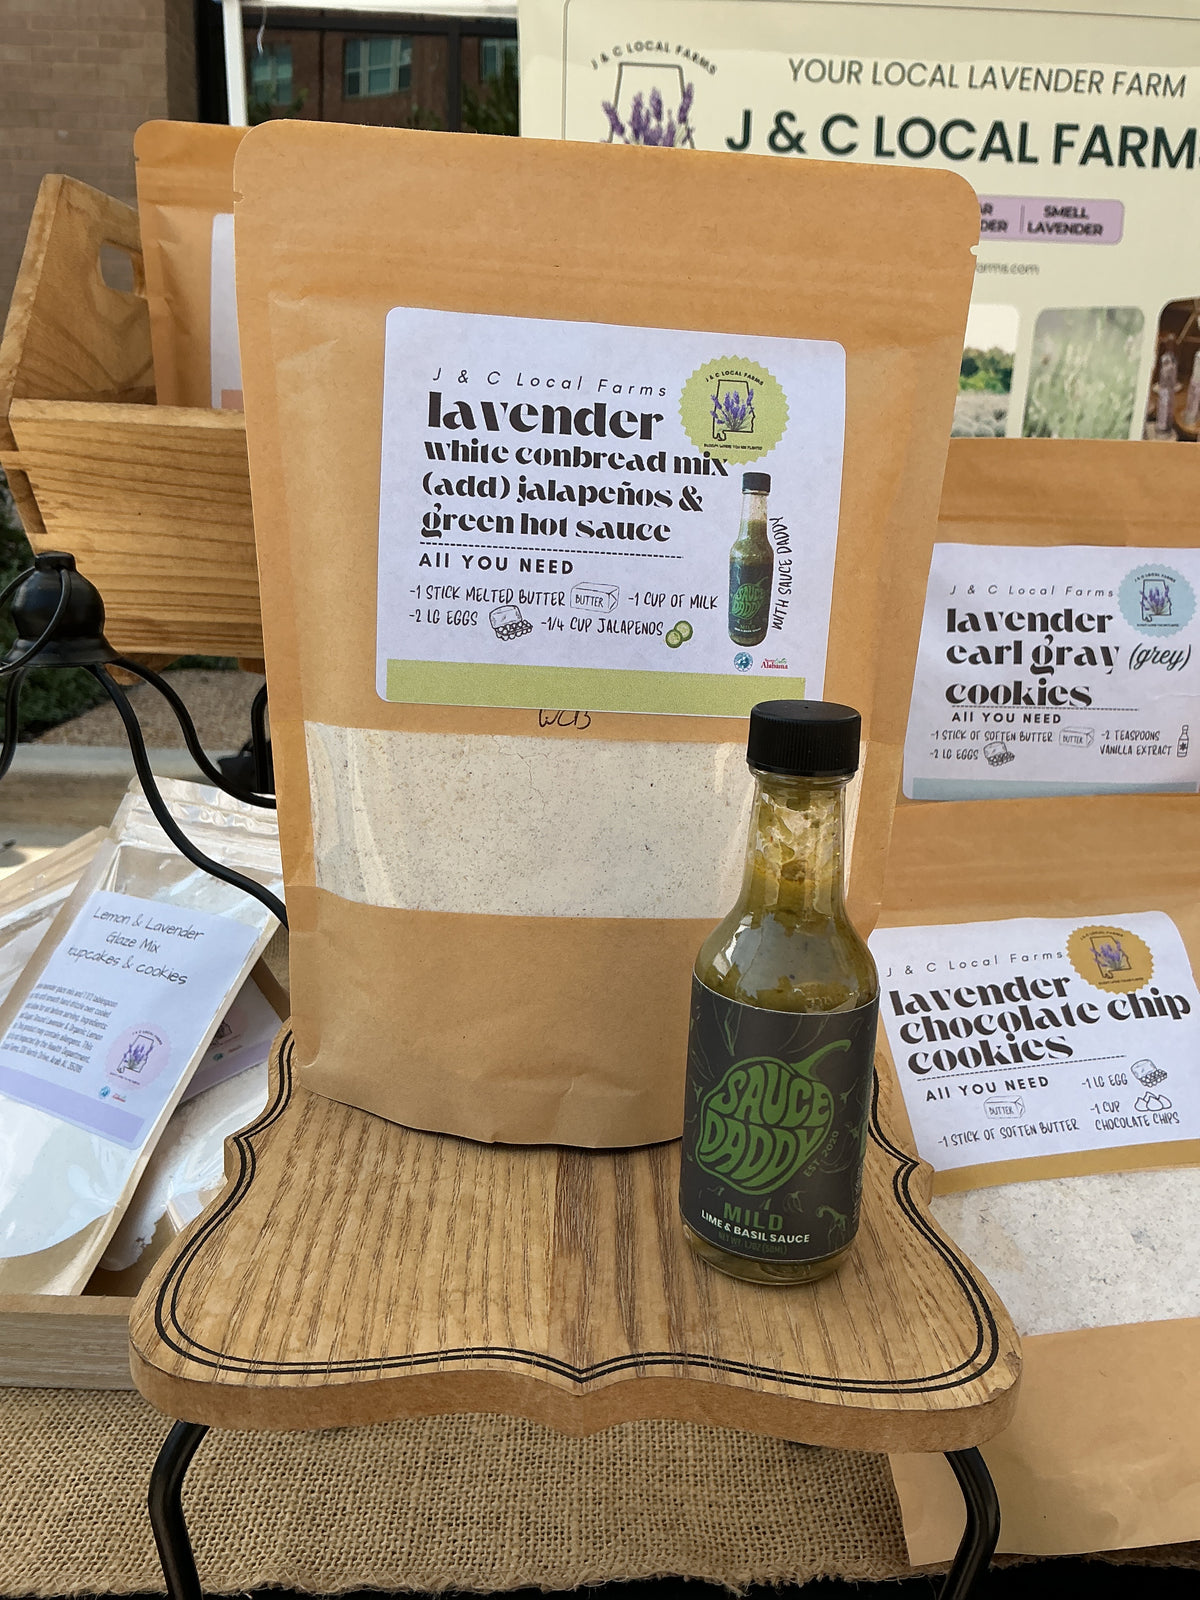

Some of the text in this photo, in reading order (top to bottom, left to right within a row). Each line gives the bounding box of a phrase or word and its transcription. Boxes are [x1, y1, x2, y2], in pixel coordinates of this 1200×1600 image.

[612, 45, 623, 57] C
[626, 40, 670, 54] LOCAL
[675, 45, 718, 75] FARMS
[789, 57, 1187, 99] YOUR LOCAL LAVENDER FARM
[726, 108, 1200, 169] J & C LOCAL FARM
[1043, 204, 1089, 220] SMELL
[1027, 220, 1103, 237] LAVENDER
[432, 367, 667, 397] J & C Local Farms
[743, 372, 764, 386] FARMS
[428, 391, 664, 441] lavender
[424, 438, 729, 477] white conbread mix
[422, 471, 704, 513] (add) jalapeños &
[420, 502, 671, 542] green hot sauce
[418, 553, 574, 575] All YOU NEED
[769, 516, 793, 631] WITH SAUCE DADDY
[409, 584, 566, 606] -1 STICK MELTED BUTTER
[575, 594, 605, 608] BUTTER
[628, 591, 719, 610] -1 CUP OF MILK
[950, 584, 1114, 598] J & C Local Farms
[408, 611, 421, 623] -2
[446, 609, 478, 627] EGGS
[541, 617, 663, 636] -1/4 CUP JALAPENOS
[947, 608, 1114, 633] lavender
[946, 634, 1192, 676] earl gray (grey)
[945, 678, 1093, 707] cookies
[951, 712, 1061, 724] All YOU NEED
[941, 729, 967, 741] STICK
[970, 730, 981, 741] OF
[984, 730, 1016, 742] SOFTEN
[1019, 731, 1053, 743] BUTTER
[1115, 729, 1160, 741] TEASPOONS
[956, 749, 979, 760] EGGS
[1100, 744, 1172, 756] VANILLA EXTRACT
[93, 906, 205, 942] Lemon & Lavender
[106, 931, 161, 953] Glaze Mix
[122, 955, 135, 969] &
[135, 964, 188, 985] cookies
[886, 951, 1064, 978] J & C Local Farms
[888, 975, 1071, 1016] lavender
[899, 987, 1191, 1045] chocolate chip
[907, 1032, 1074, 1075] cookies
[925, 1076, 1048, 1102] All YOU NEED
[1108, 1073, 1128, 1087] EGG
[710, 1063, 830, 1127] SAUCE
[1102, 1100, 1120, 1113] CUP
[988, 1105, 1015, 1116] BUTTER
[1095, 1112, 1180, 1131] CHOCOLATE CHIPS
[822, 1131, 839, 1157] 2020
[937, 1118, 1080, 1147] -1 STICK OF SOFTEN BUTTER
[699, 1108, 825, 1188] DADDY
[701, 1209, 810, 1244] LIME & BASIL SAUCE
[723, 1202, 784, 1231] MILD
